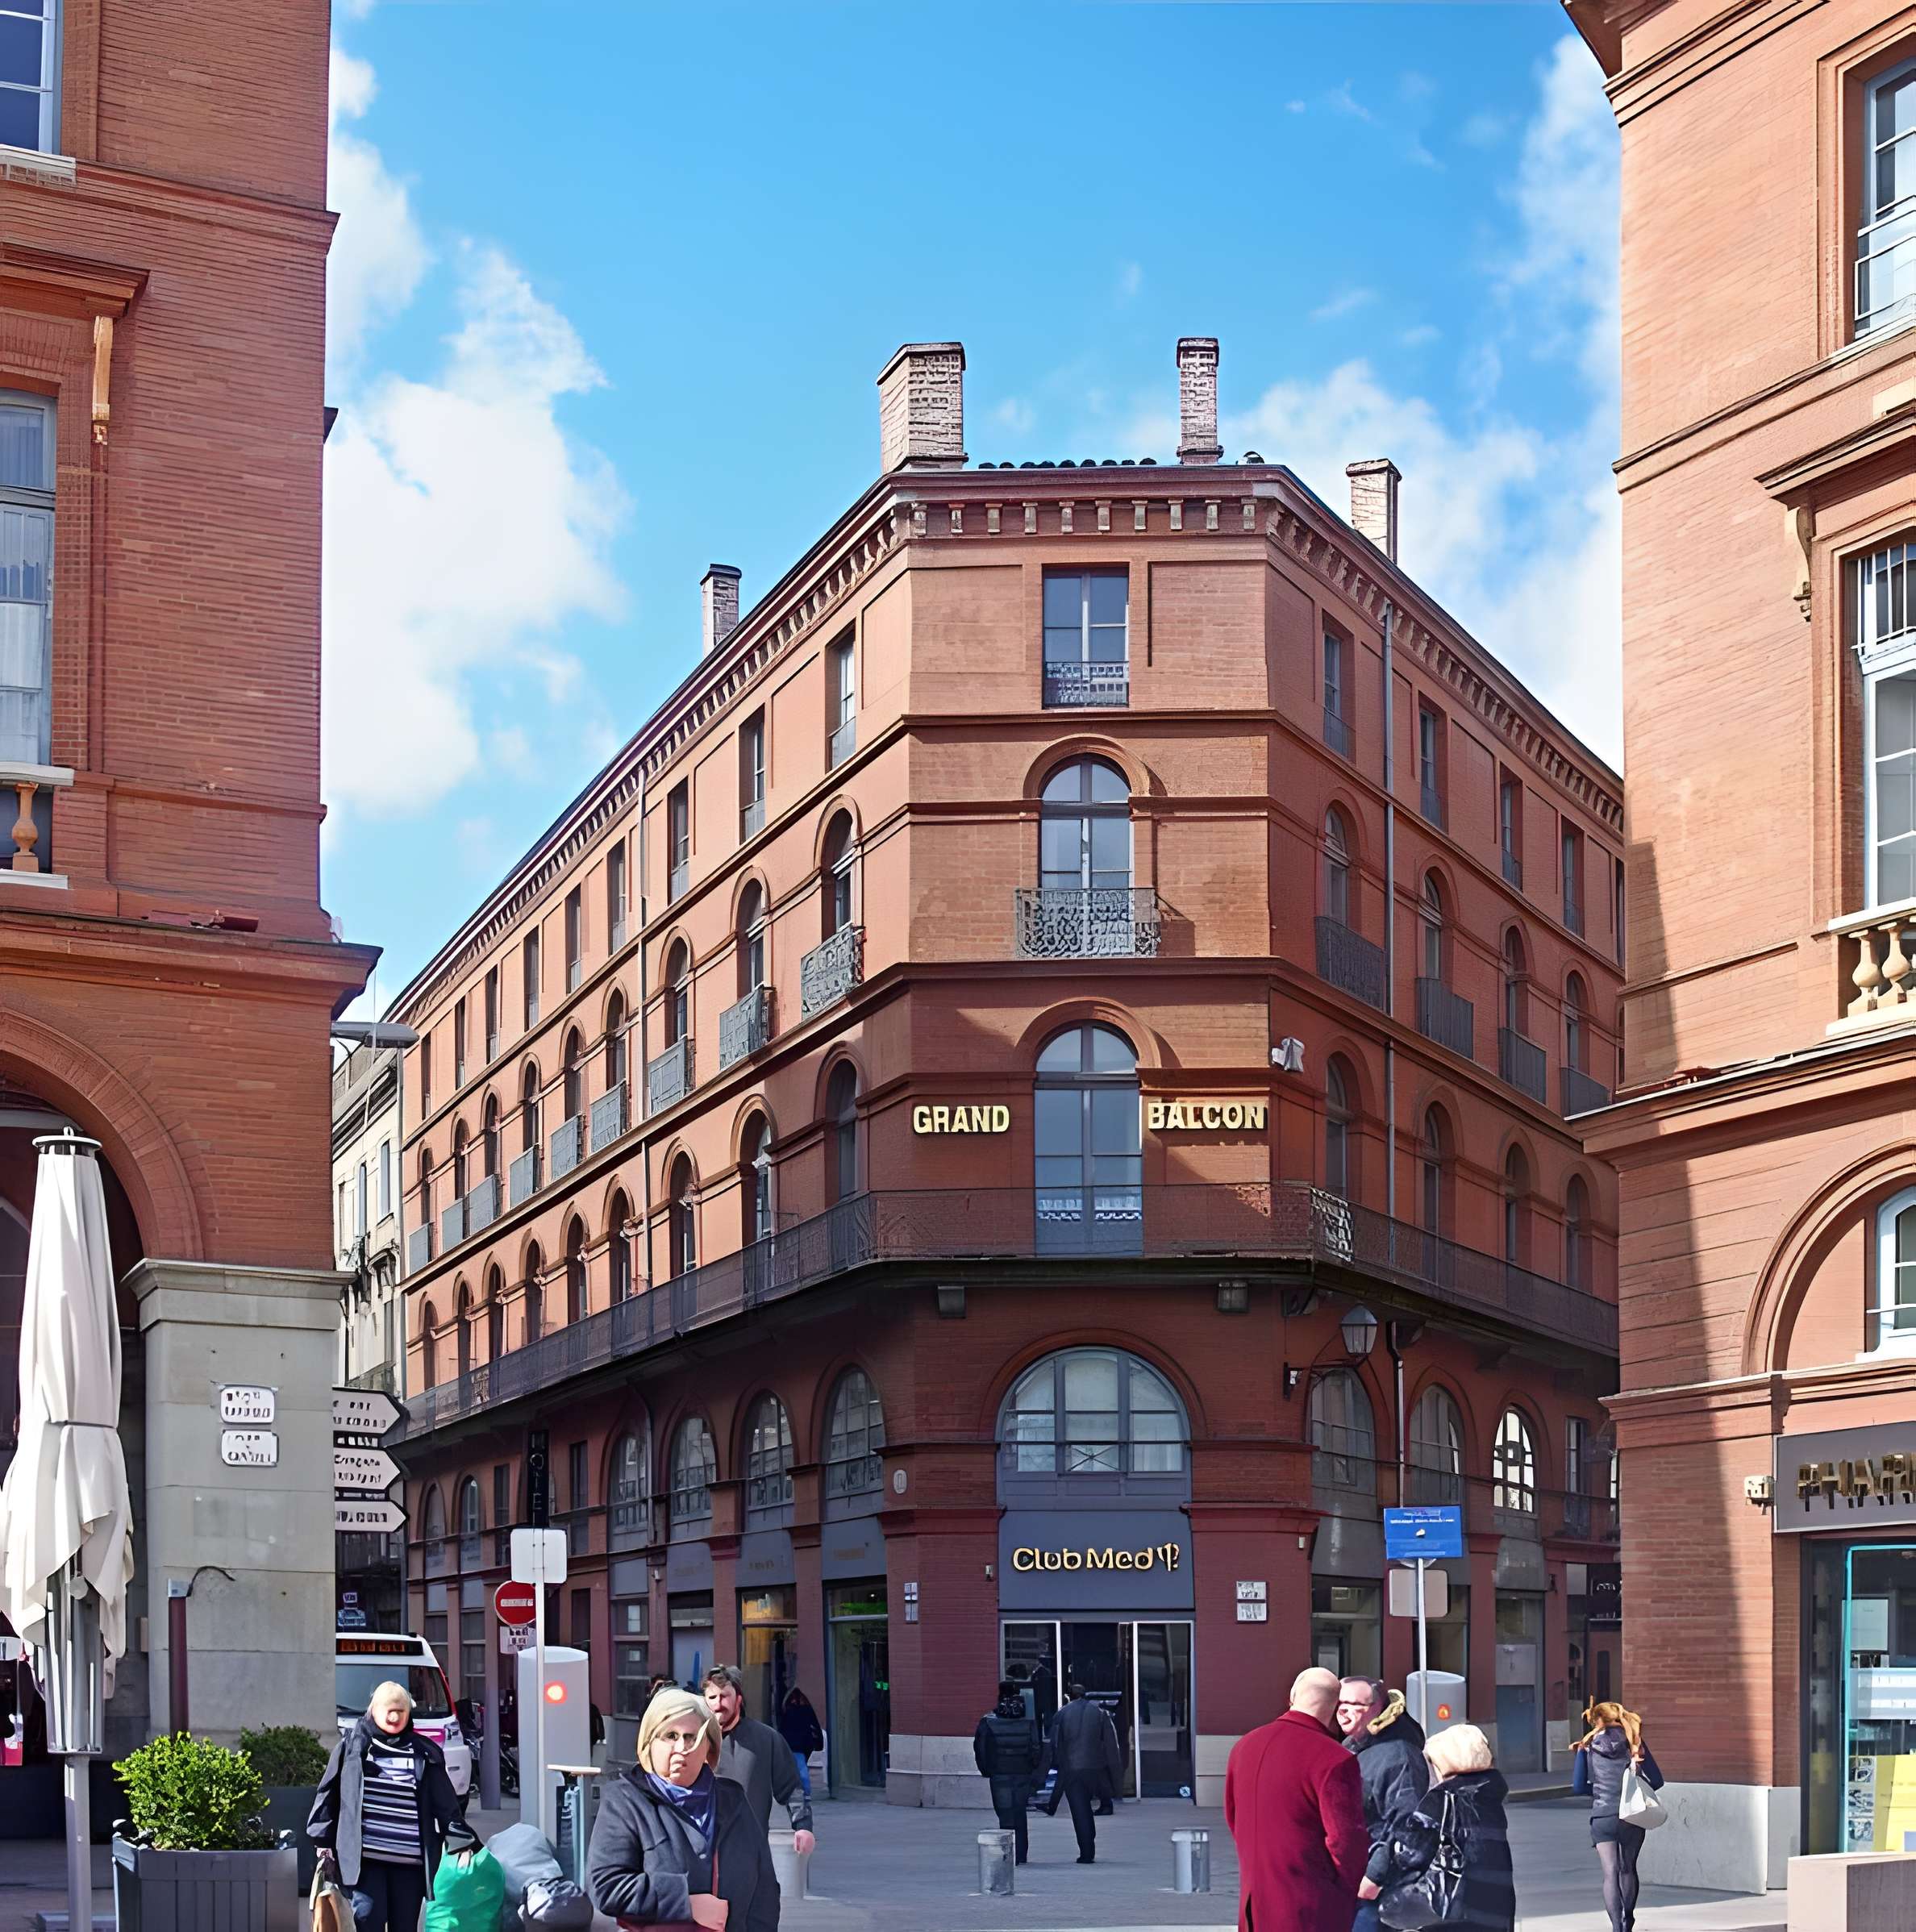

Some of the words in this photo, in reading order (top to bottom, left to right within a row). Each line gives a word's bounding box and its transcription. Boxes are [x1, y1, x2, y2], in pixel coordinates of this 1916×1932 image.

[913, 1105, 1010, 1134] GRAND
[1148, 1102, 1265, 1130] BALCON
[1013, 1547, 1082, 1571] Club
[1086, 1547, 1153, 1570] Med
